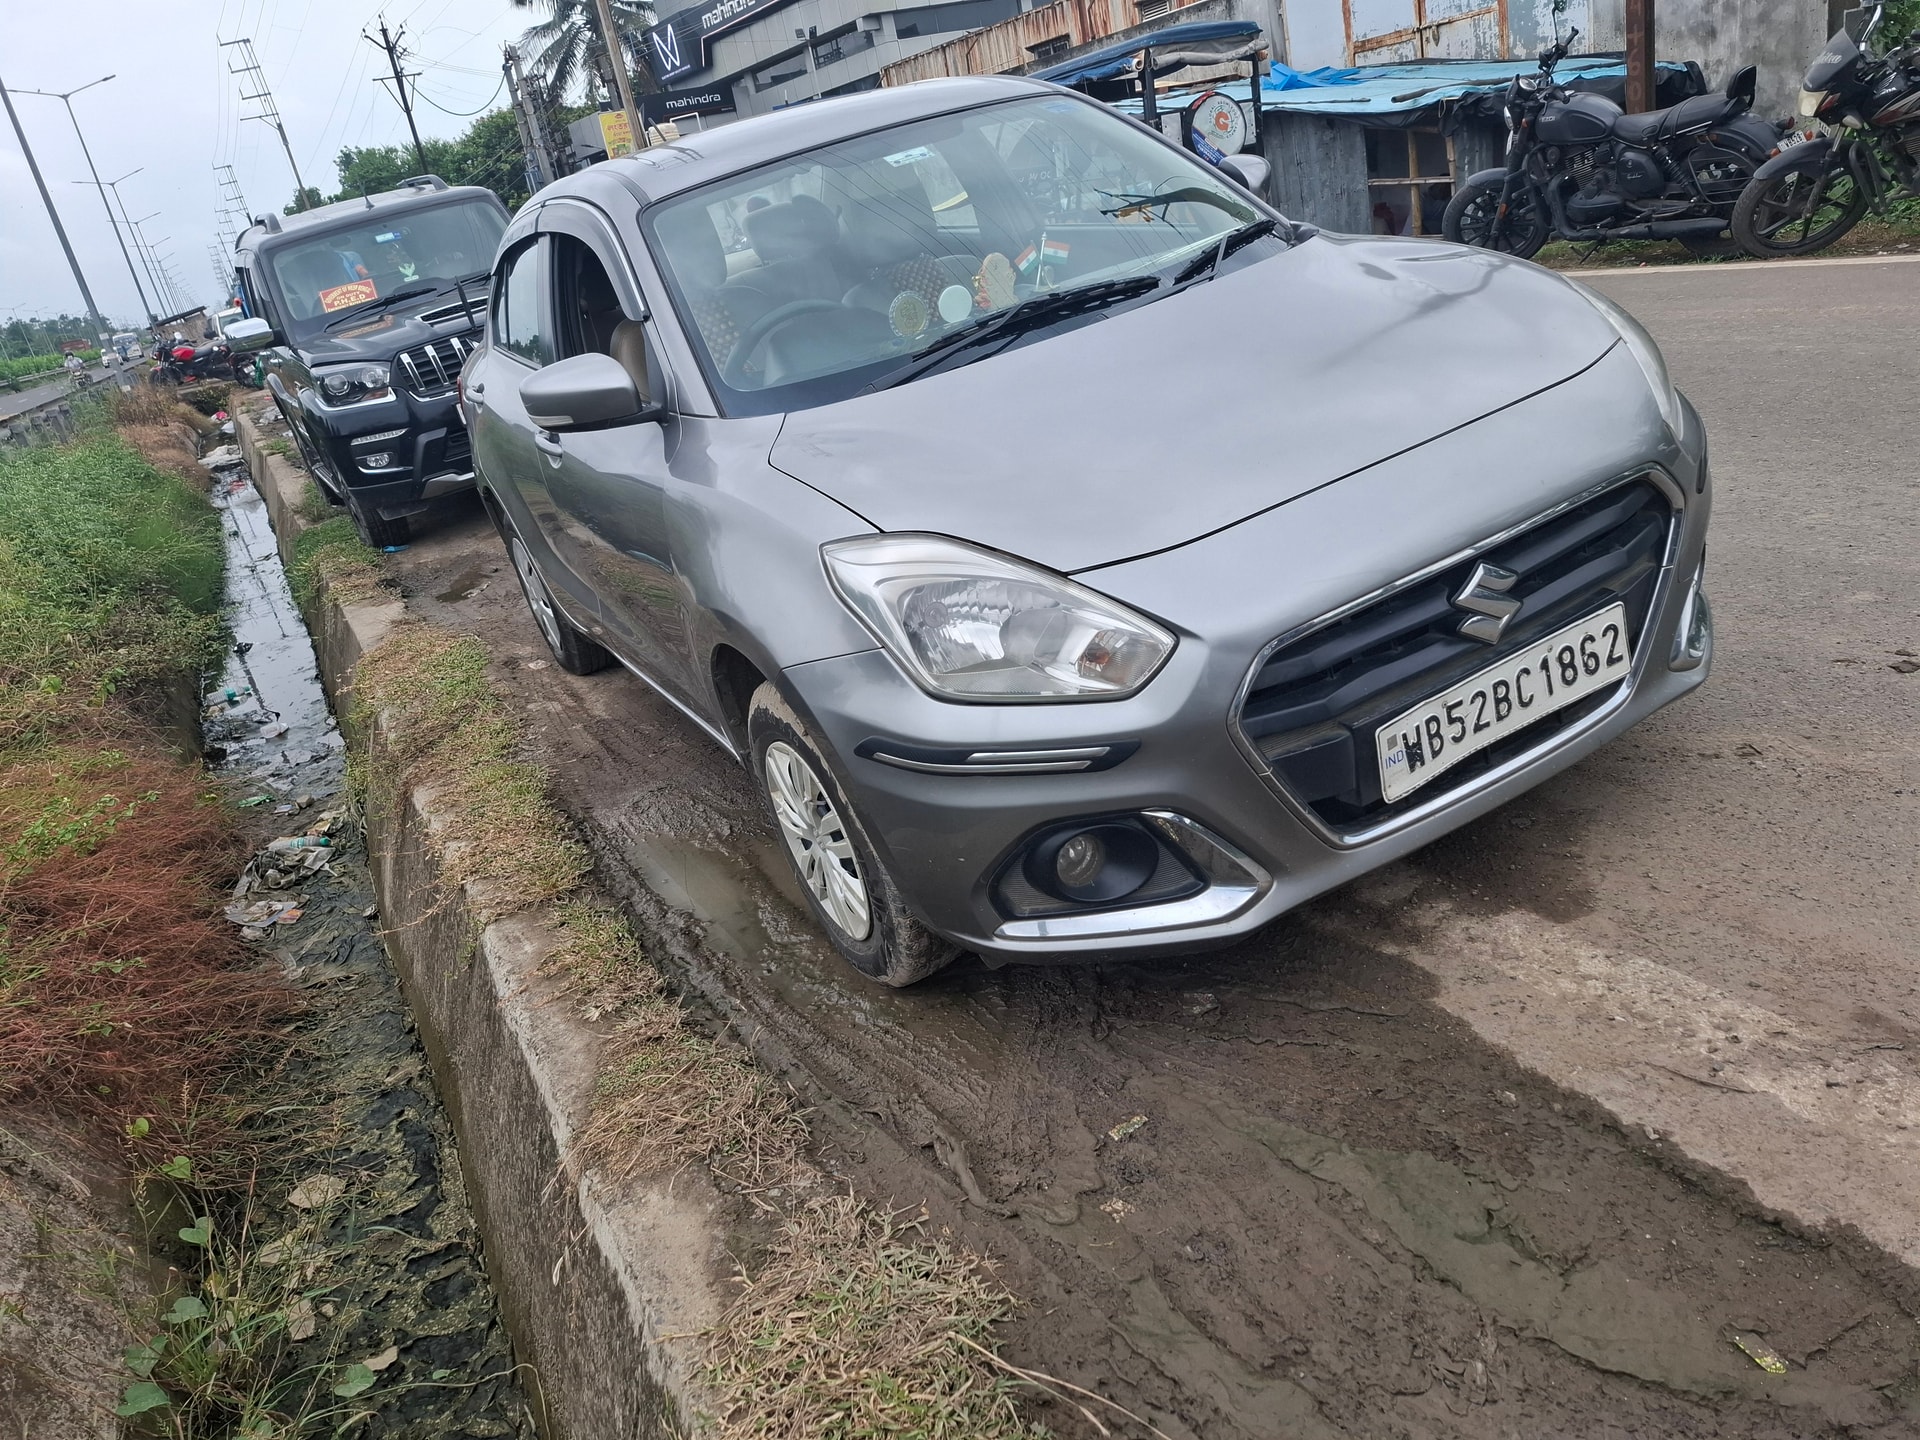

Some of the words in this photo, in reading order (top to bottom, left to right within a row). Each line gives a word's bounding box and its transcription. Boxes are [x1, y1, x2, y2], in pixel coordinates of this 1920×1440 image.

[666, 93, 721, 109] mahindra
[1401, 623, 1624, 774] WB52BC1862
[1385, 750, 1404, 770] IND
